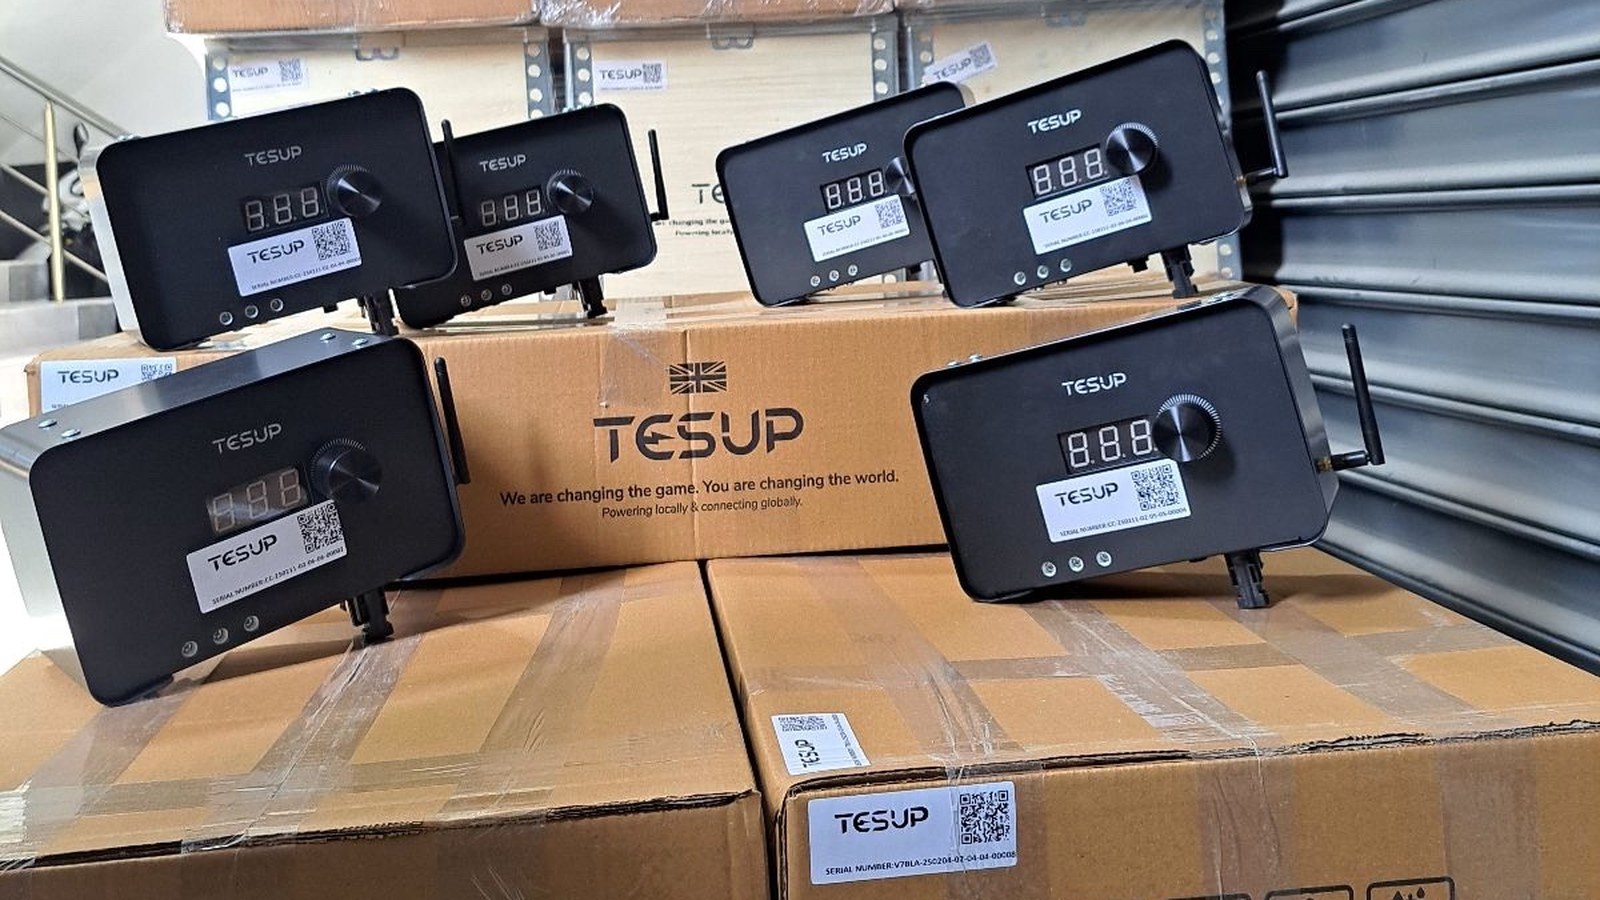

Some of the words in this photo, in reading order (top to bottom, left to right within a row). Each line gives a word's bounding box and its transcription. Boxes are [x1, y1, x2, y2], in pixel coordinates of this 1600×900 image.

[232, 66, 268, 78] TESUP
[600, 68, 642, 80] TESUP
[933, 57, 972, 80] TESUP
[1028, 109, 1082, 135] TESUP
[245, 146, 302, 166] TESUP
[479, 154, 527, 172] TESUP
[822, 143, 867, 163] TESUP
[1039, 199, 1092, 224] TESUP
[817, 215, 861, 236] TESUP
[247, 240, 305, 263] TESUP
[476, 234, 523, 255] TESUP
[57, 369, 119, 384] TESUP
[1061, 372, 1127, 396] TESUP
[212, 423, 282, 455] TESUP
[593, 407, 804, 463] TESUP
[500, 491, 525, 505] We
[530, 492, 553, 504] are
[557, 486, 624, 503] changing
[628, 484, 651, 498] the
[655, 484, 699, 500] game.
[703, 480, 729, 494] You
[734, 480, 756, 492] are
[759, 474, 824, 490] changing
[828, 472, 851, 487] the
[854, 470, 899, 484] world.
[1054, 482, 1119, 507] TESUP
[602, 505, 653, 519] Powering
[655, 503, 688, 516] locally
[691, 502, 699, 513] &
[701, 499, 758, 513] connecting
[760, 496, 803, 510] globally.
[207, 534, 278, 572] TESUP
[212, 592, 234, 605] SERIAL
[794, 739, 822, 768] TESUP
[834, 806, 929, 834] TESUP
[826, 866, 853, 876] SERIAL
